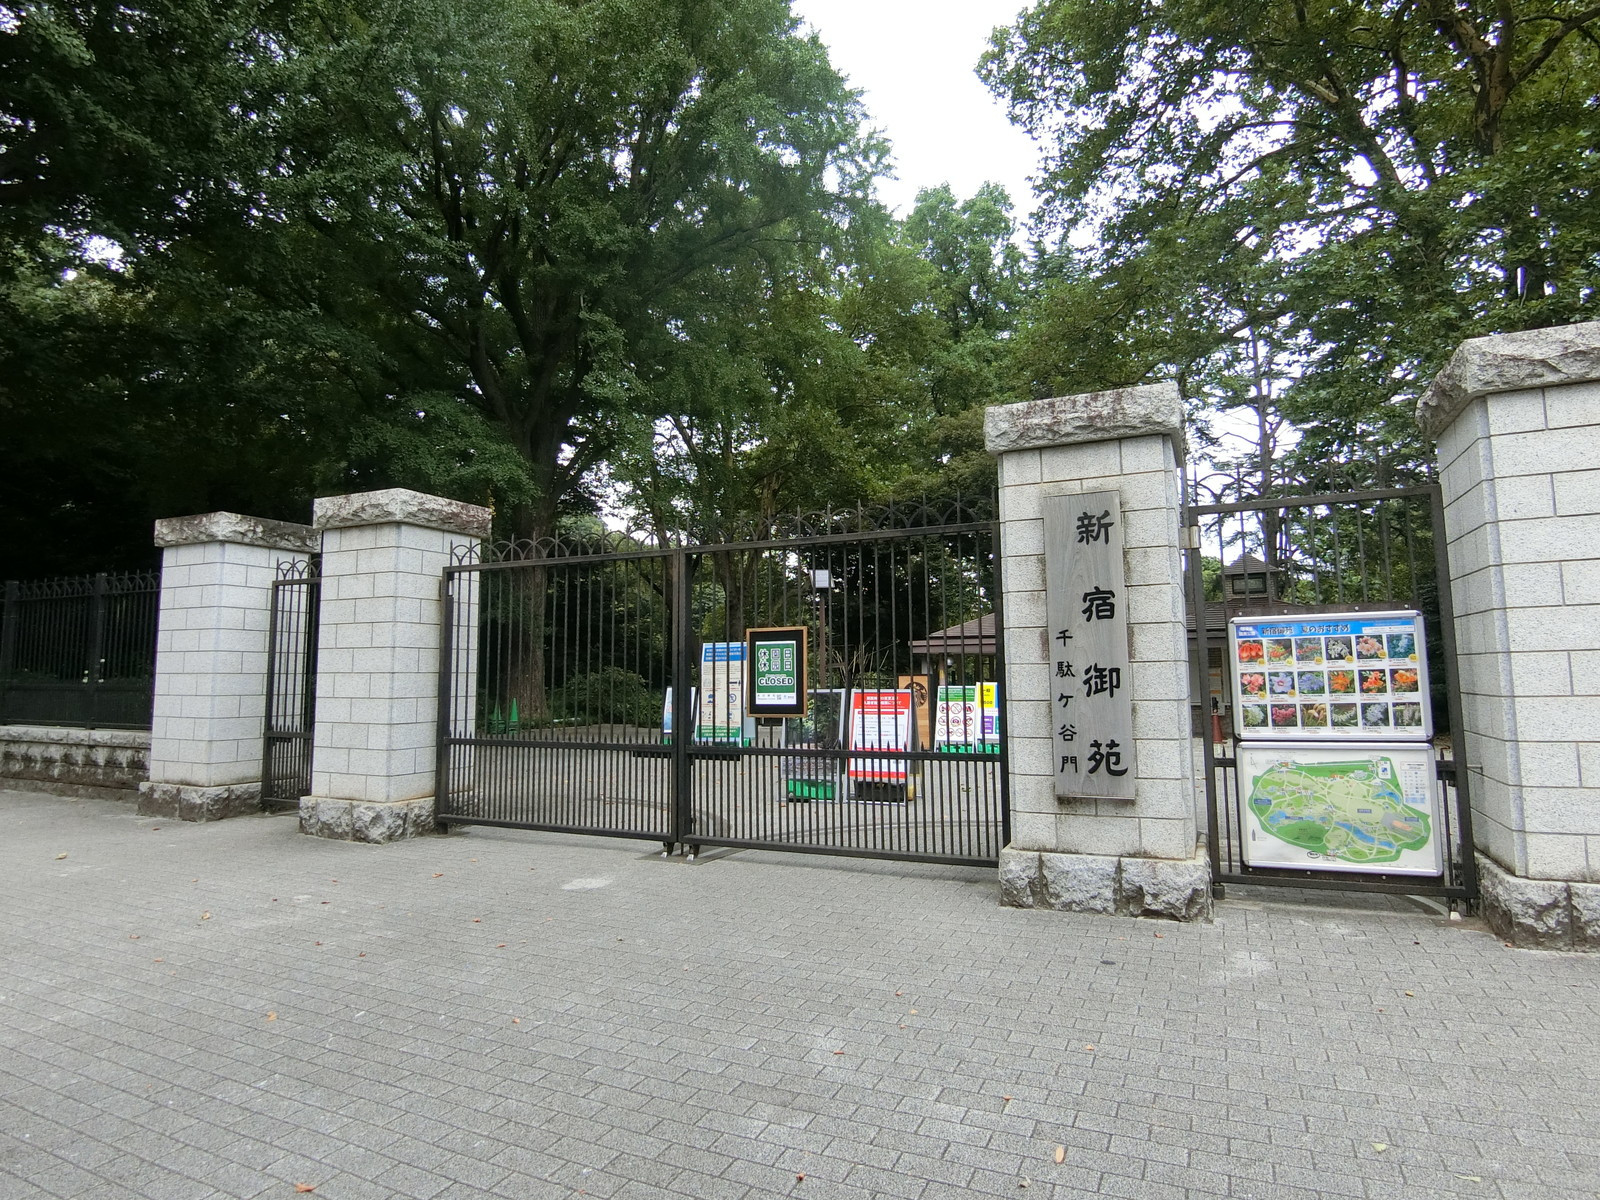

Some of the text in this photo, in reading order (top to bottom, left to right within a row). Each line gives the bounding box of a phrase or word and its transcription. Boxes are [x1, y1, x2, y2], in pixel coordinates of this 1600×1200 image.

[759, 677, 793, 685] CLOSED
[1076, 509, 1129, 776] 新宿御苑
